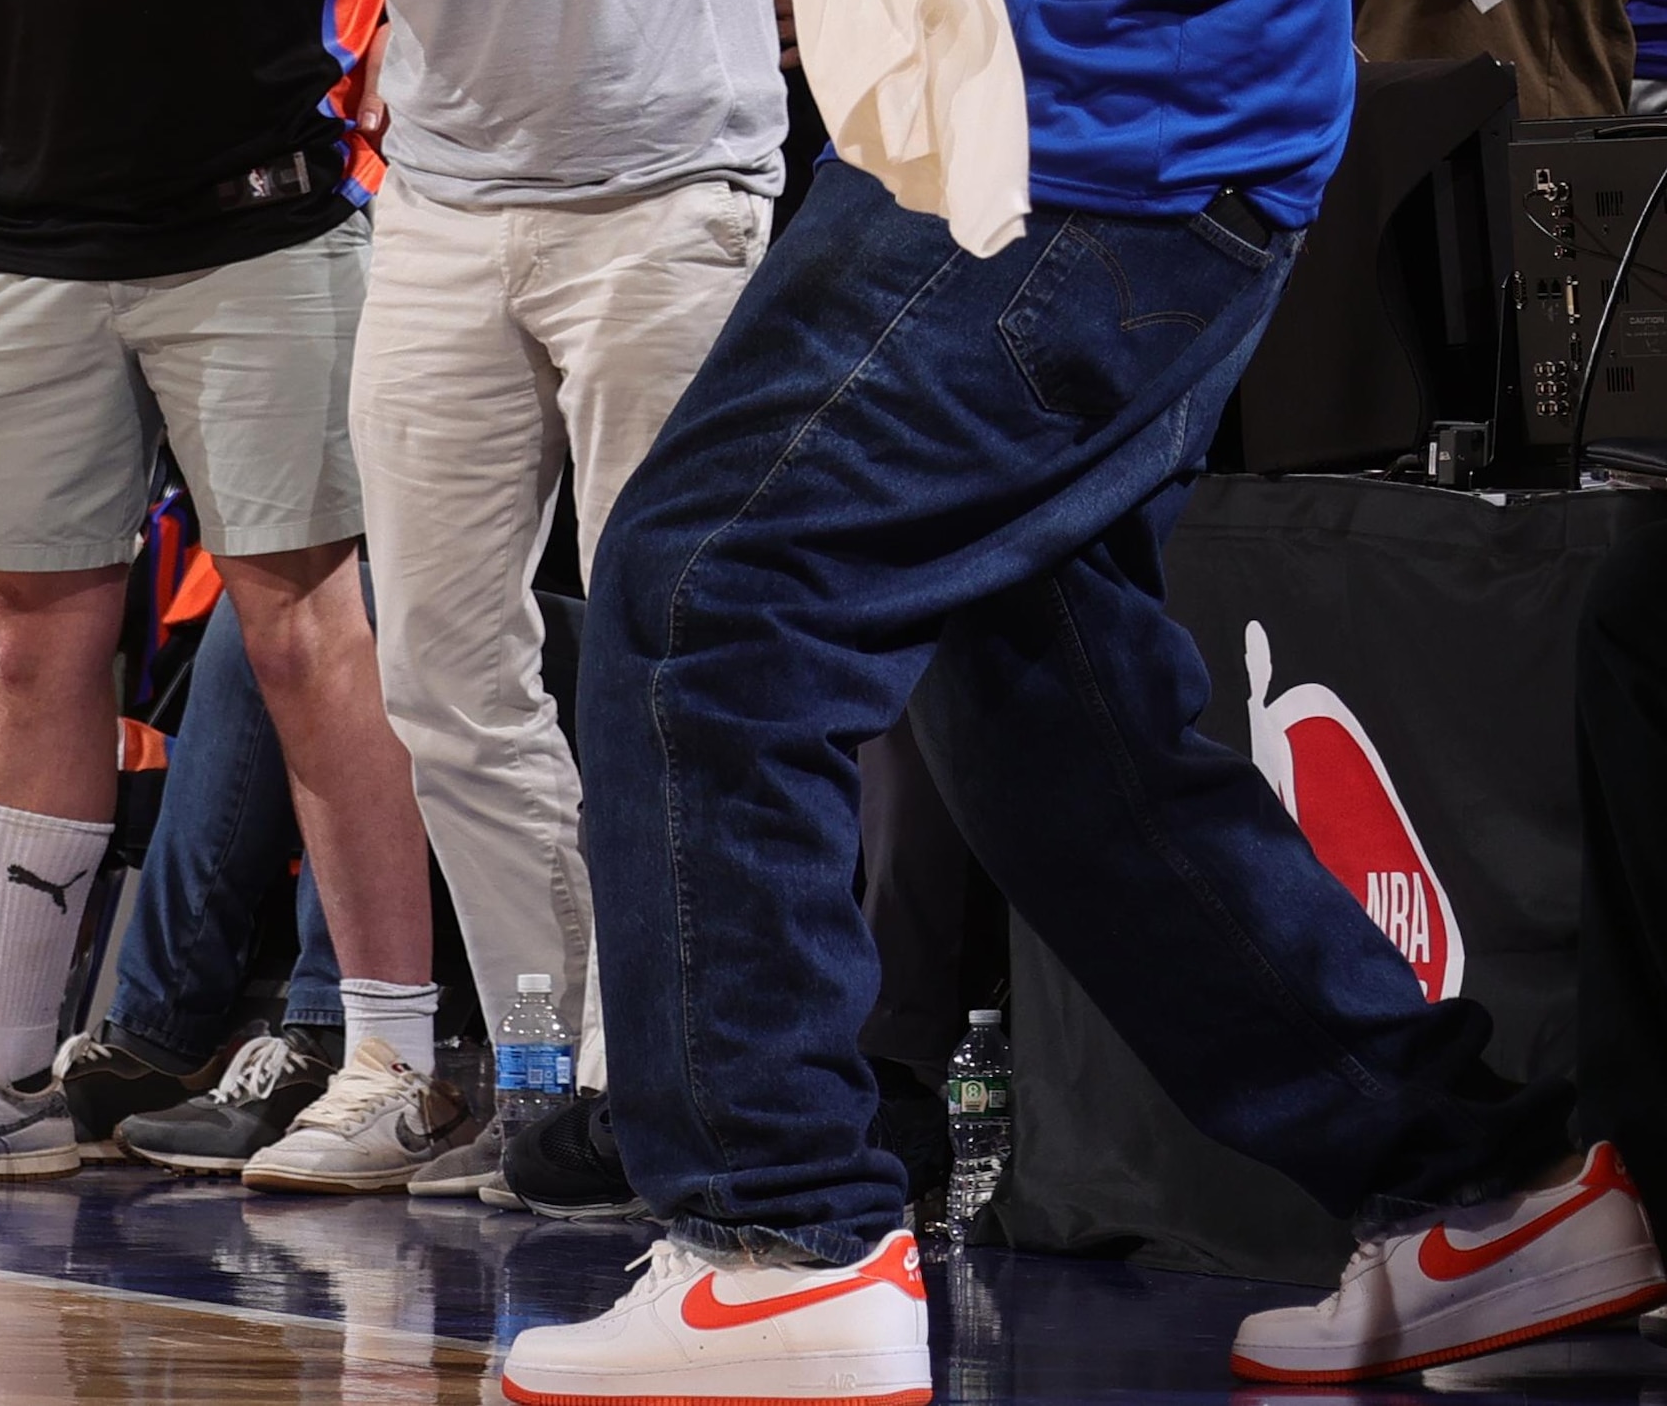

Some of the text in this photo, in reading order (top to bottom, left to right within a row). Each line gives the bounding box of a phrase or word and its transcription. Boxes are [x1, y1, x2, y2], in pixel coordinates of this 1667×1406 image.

[1629, 315, 1663, 325] CAUTION
[1366, 872, 1430, 963] NBA
[827, 1371, 857, 1390] AIR
